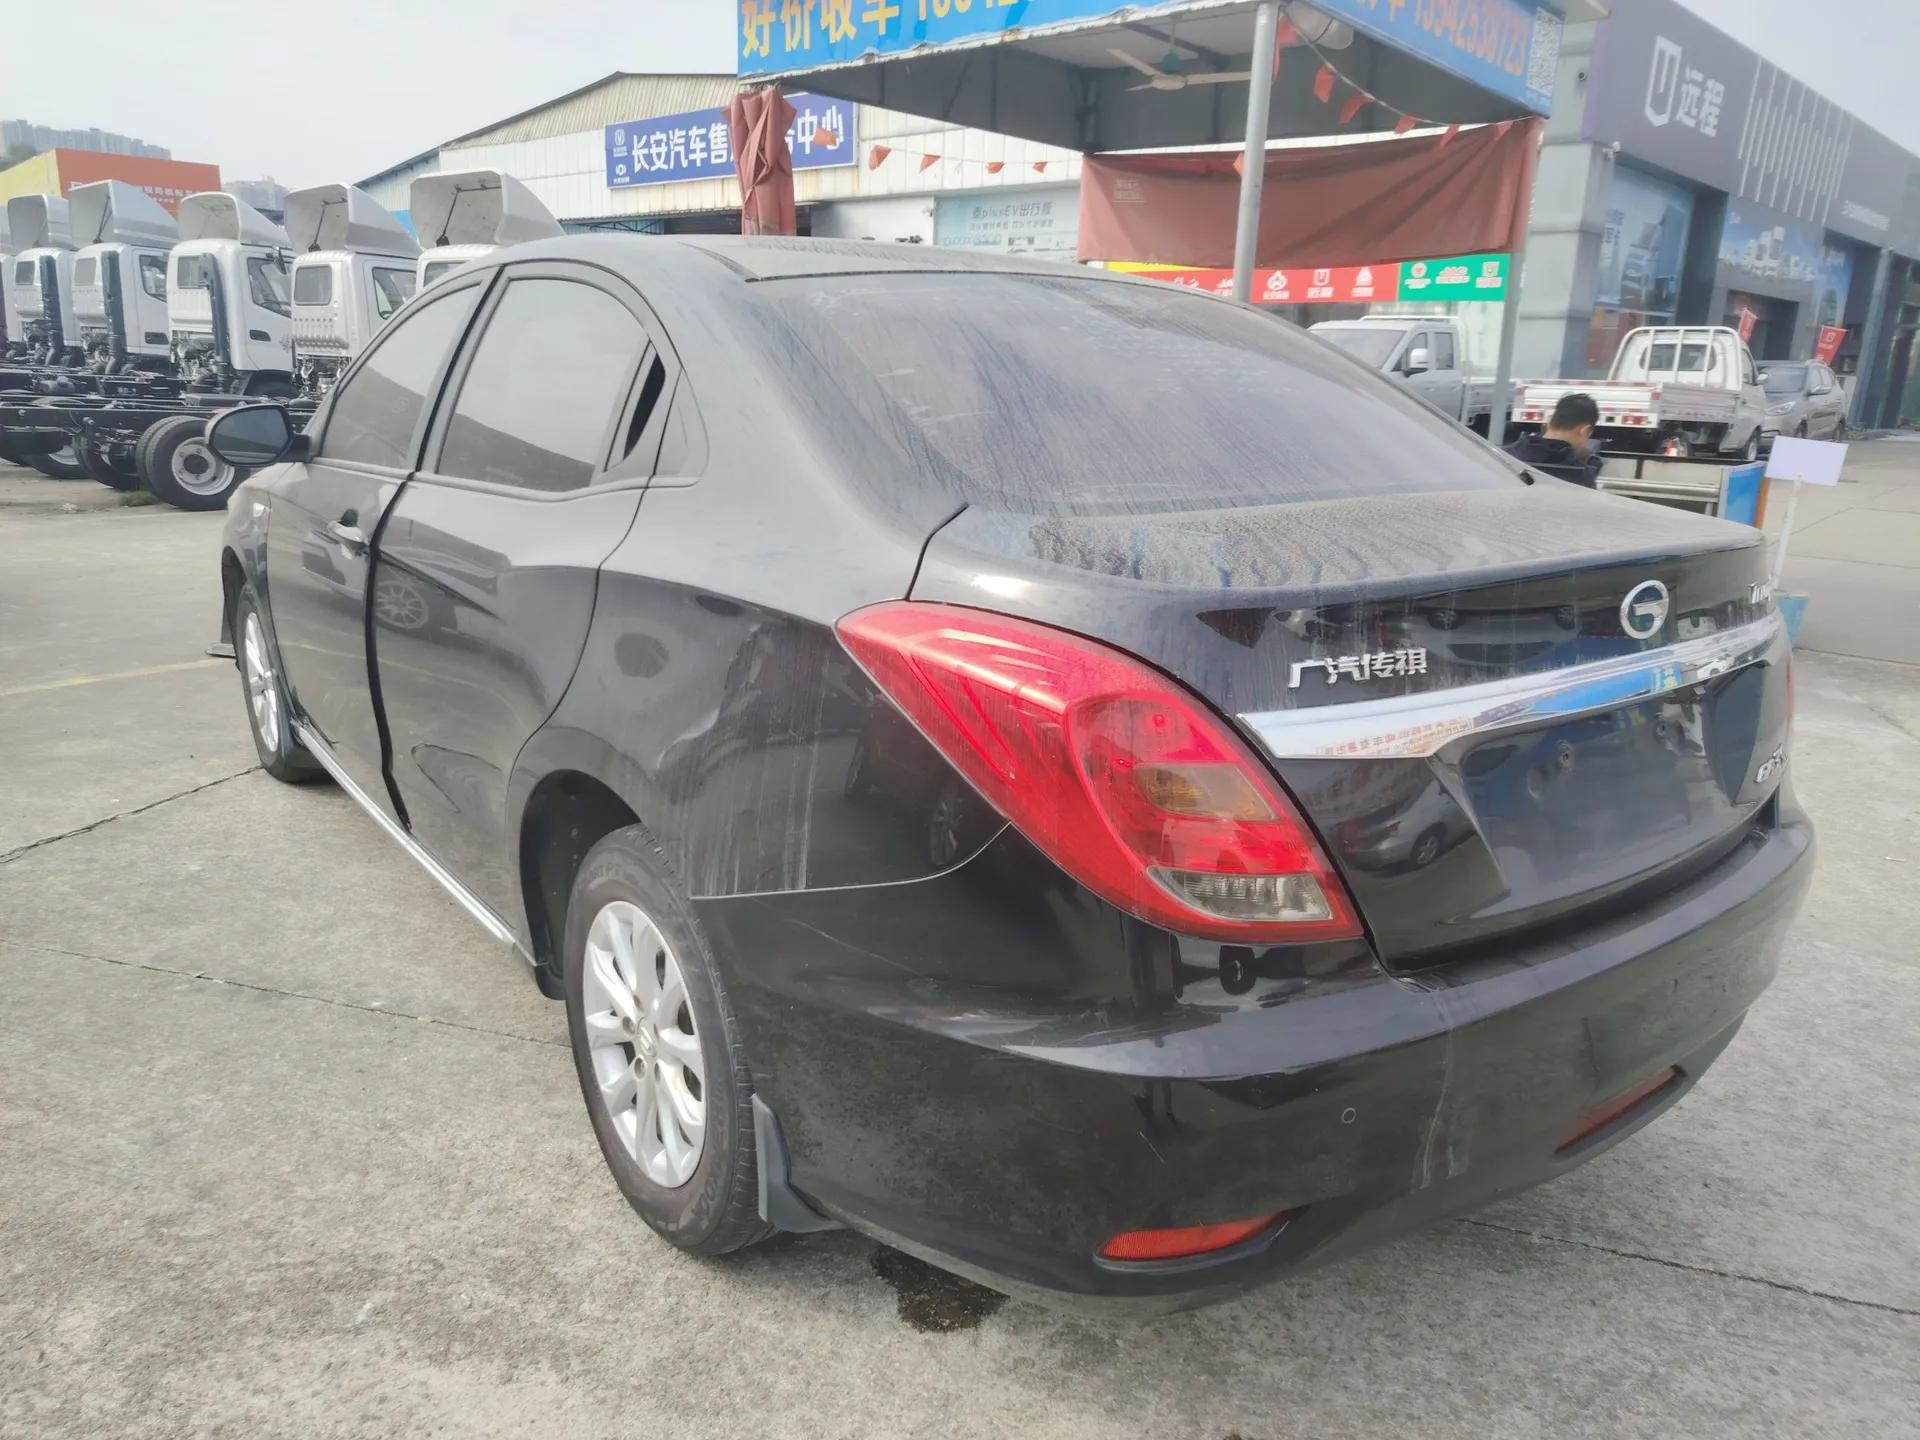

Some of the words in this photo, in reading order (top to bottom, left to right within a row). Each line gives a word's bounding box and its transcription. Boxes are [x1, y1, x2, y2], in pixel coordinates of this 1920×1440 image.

[631, 105, 845, 172] 长安汽车售中心
[1288, 647, 1428, 688] 广汽传祺
